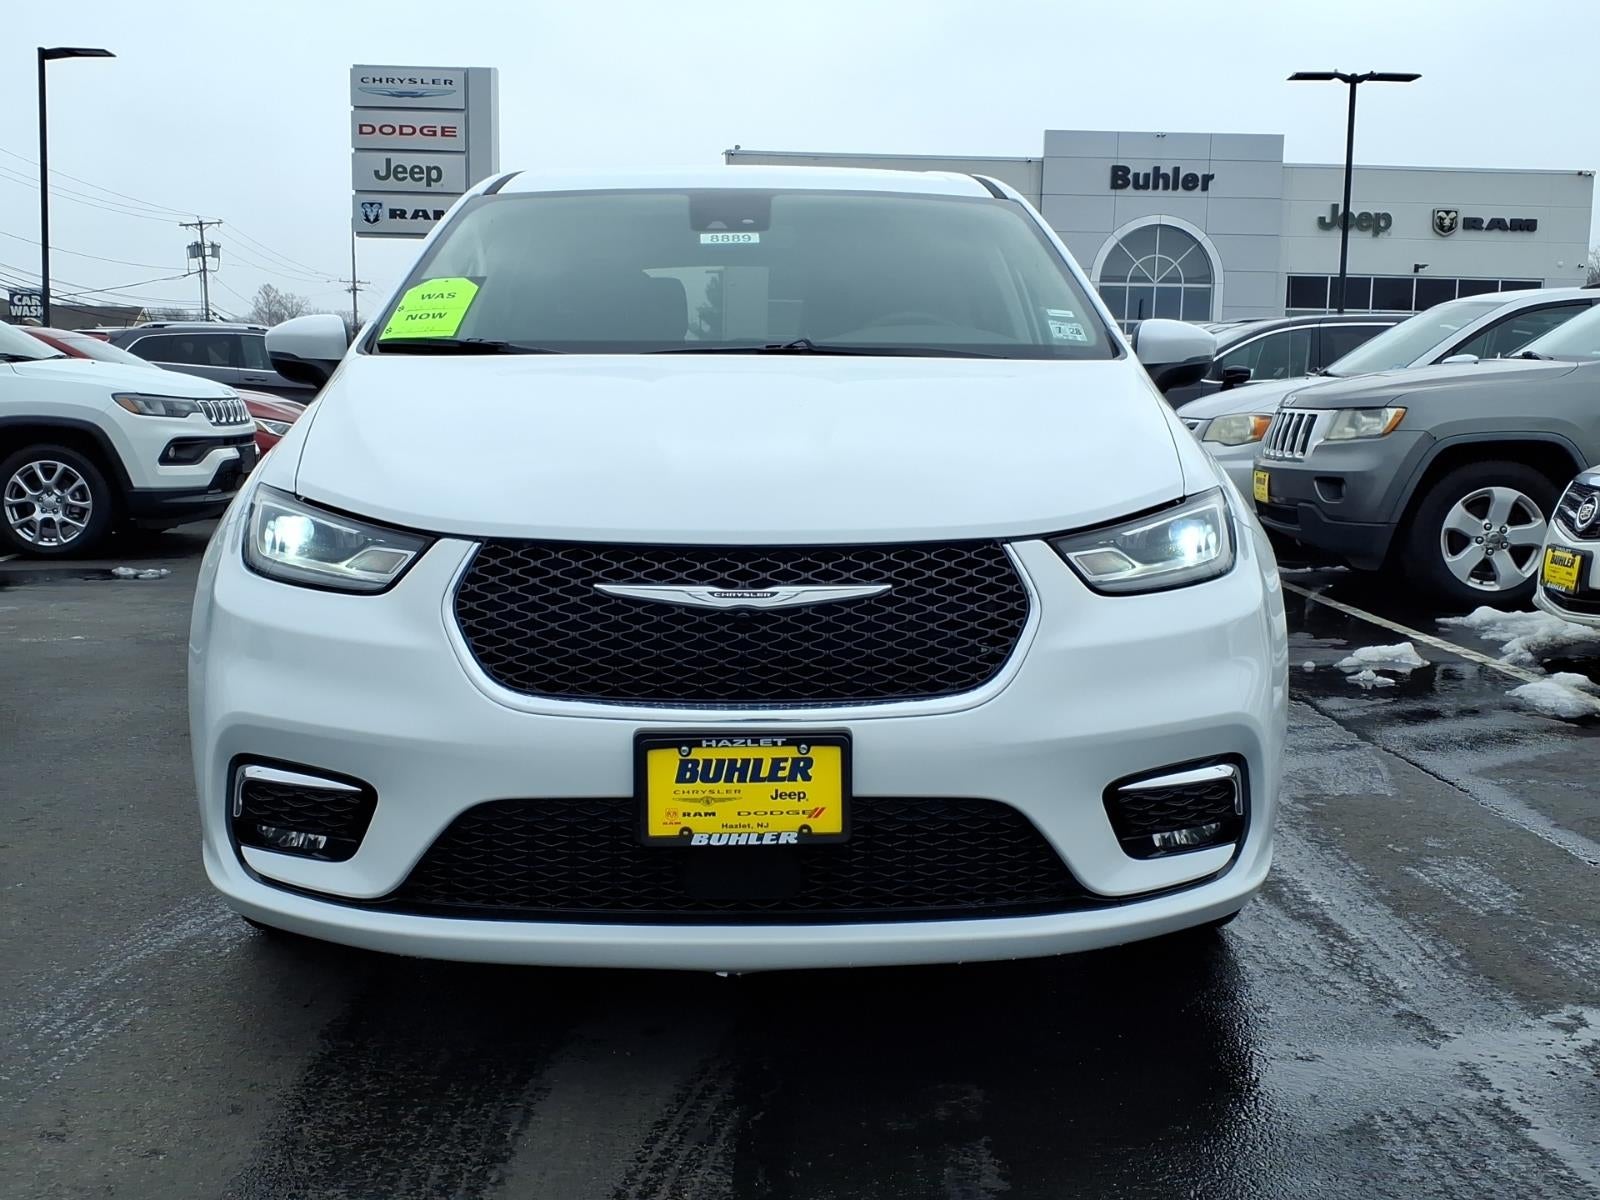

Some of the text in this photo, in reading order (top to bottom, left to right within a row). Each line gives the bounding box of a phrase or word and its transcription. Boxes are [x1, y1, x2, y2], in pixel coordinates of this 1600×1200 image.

[360, 76, 454, 86] CHRYSLER
[358, 123, 457, 138] DODGE
[373, 157, 443, 187] Jeep
[1110, 164, 1215, 192] Buhler
[1462, 216, 1538, 232] RAM
[710, 234, 752, 243] 8889
[13, 295, 41, 305] CAR
[421, 292, 457, 300] WAS
[405, 312, 448, 321] NOW
[701, 738, 787, 748] HAZLET
[674, 756, 814, 784] BUHLER
[770, 789, 806, 802] Jeep
[690, 832, 799, 846] BUHLER
